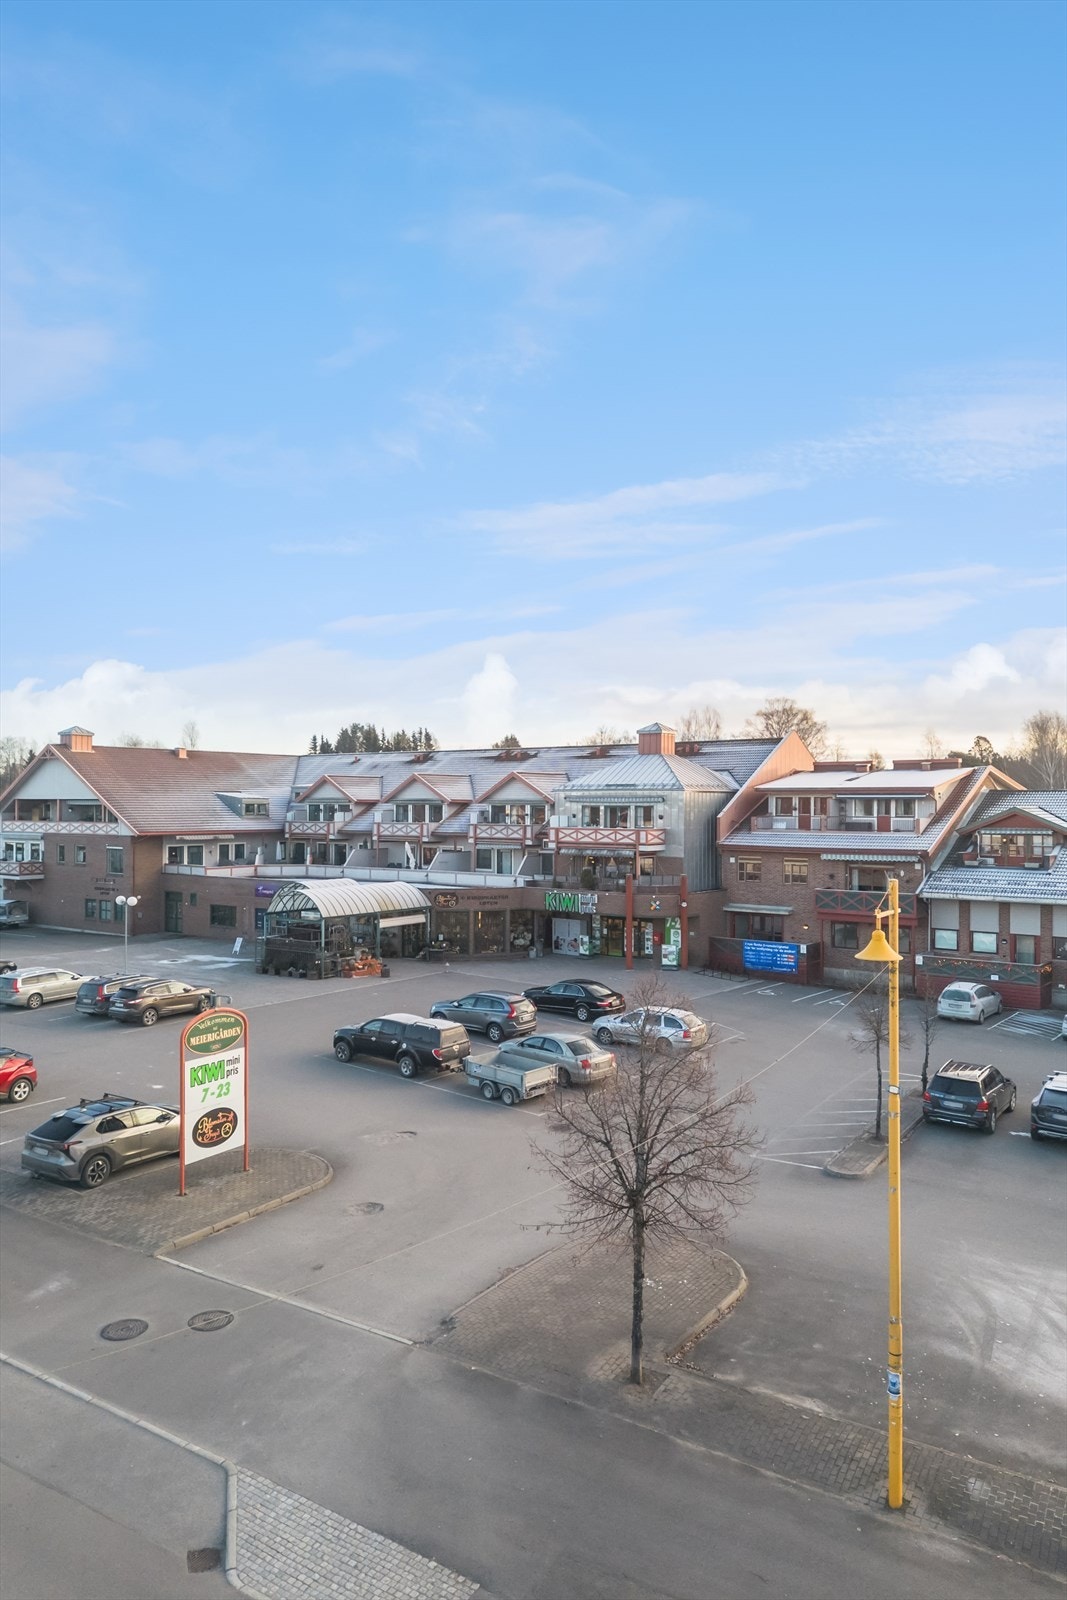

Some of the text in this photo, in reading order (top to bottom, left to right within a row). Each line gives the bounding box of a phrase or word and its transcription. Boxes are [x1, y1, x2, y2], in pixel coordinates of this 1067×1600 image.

[545, 892, 579, 912] KIWI
[197, 1017, 235, 1029] Velkommen
[189, 1026, 242, 1046] MEIERIGÅRDEN
[226, 1054, 240, 1067] mini
[190, 1060, 225, 1088] KIWI
[226, 1066, 239, 1079] pris
